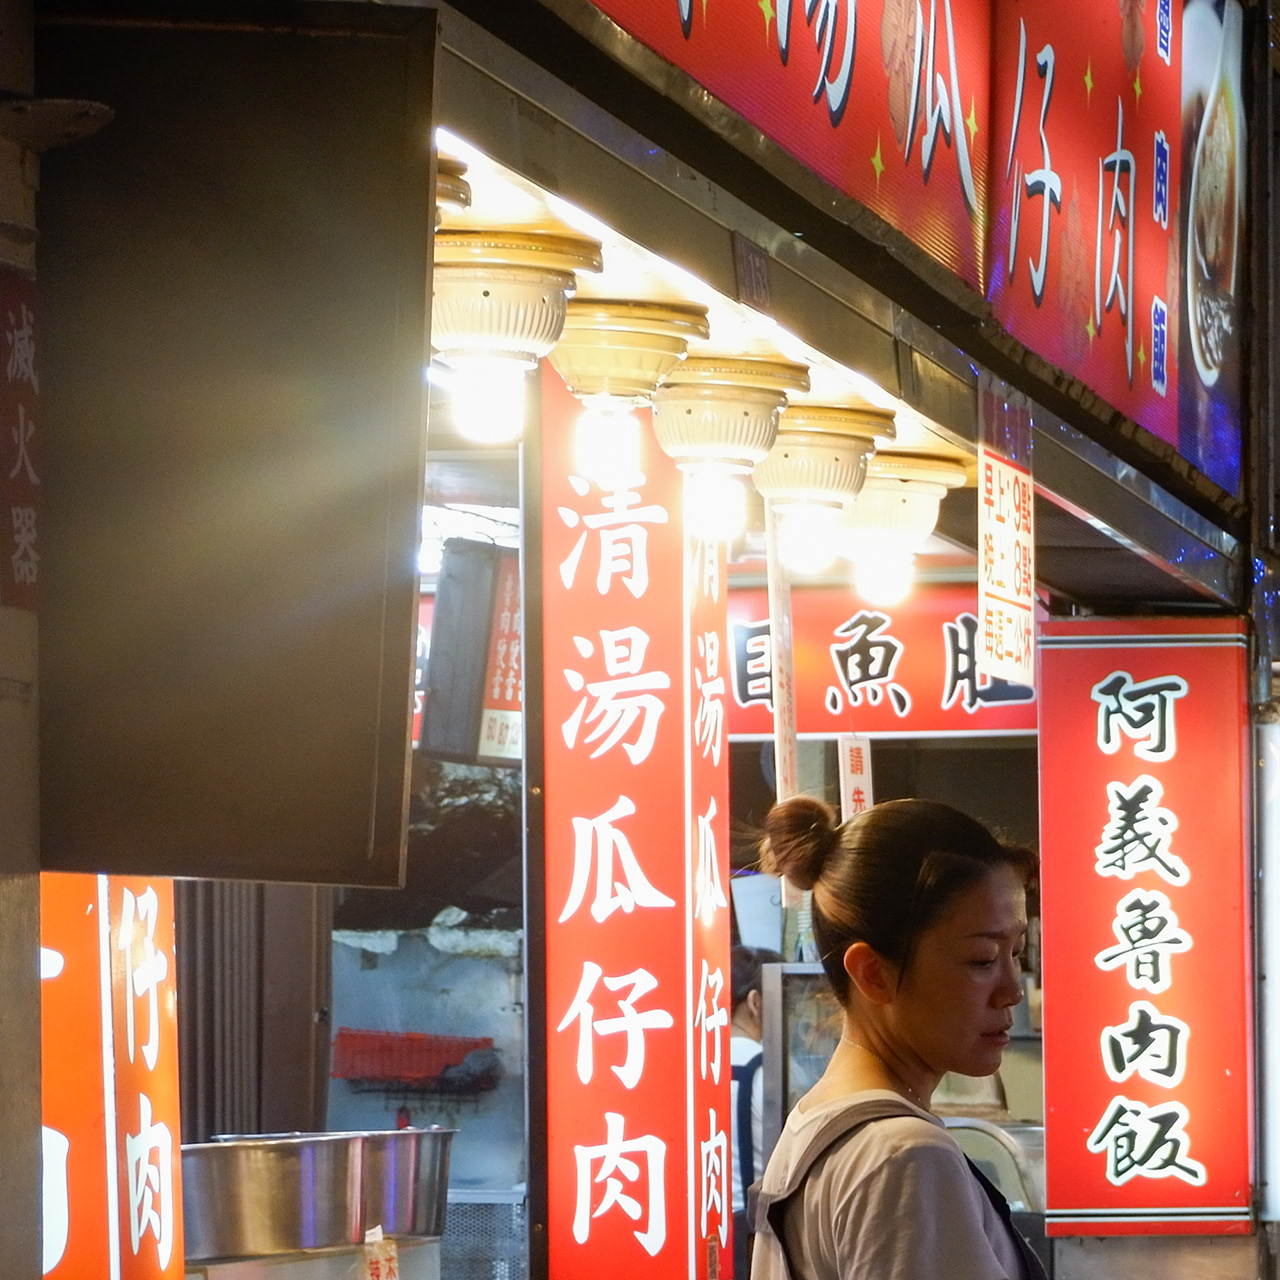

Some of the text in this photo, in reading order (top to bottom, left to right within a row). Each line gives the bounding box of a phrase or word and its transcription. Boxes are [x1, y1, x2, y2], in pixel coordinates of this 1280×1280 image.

[6, 301, 41, 585] 滅火器
[557, 473, 676, 1257] 清湯瓜仔肉
[1087, 670, 1207, 1188] 阿義魯肉飯
